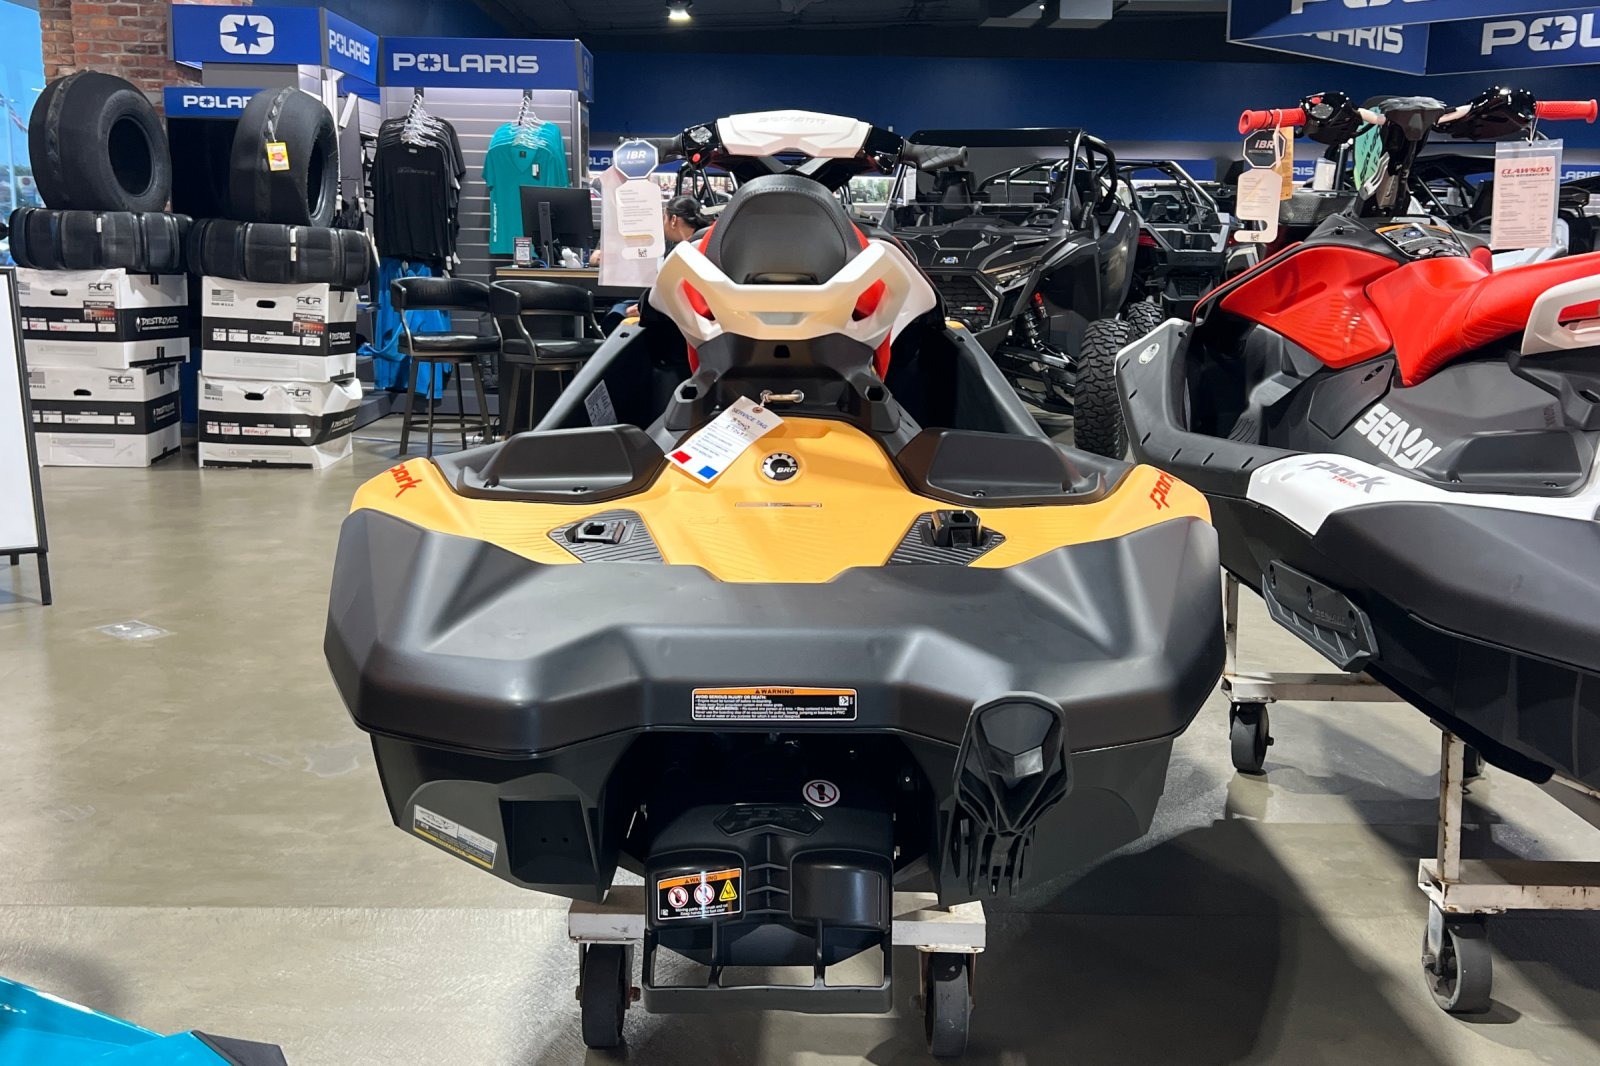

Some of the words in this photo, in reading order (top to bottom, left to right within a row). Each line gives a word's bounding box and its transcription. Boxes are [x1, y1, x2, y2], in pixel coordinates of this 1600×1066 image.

[328, 29, 370, 66] POLARIS
[393, 53, 539, 74] POLARIS
[1502, 166, 1552, 174] CLAWSON
[141, 316, 179, 326] DESTROYER
[732, 408, 755, 422] SERVICE
[756, 420, 768, 430] TAG
[690, 875, 718, 884] WAING
